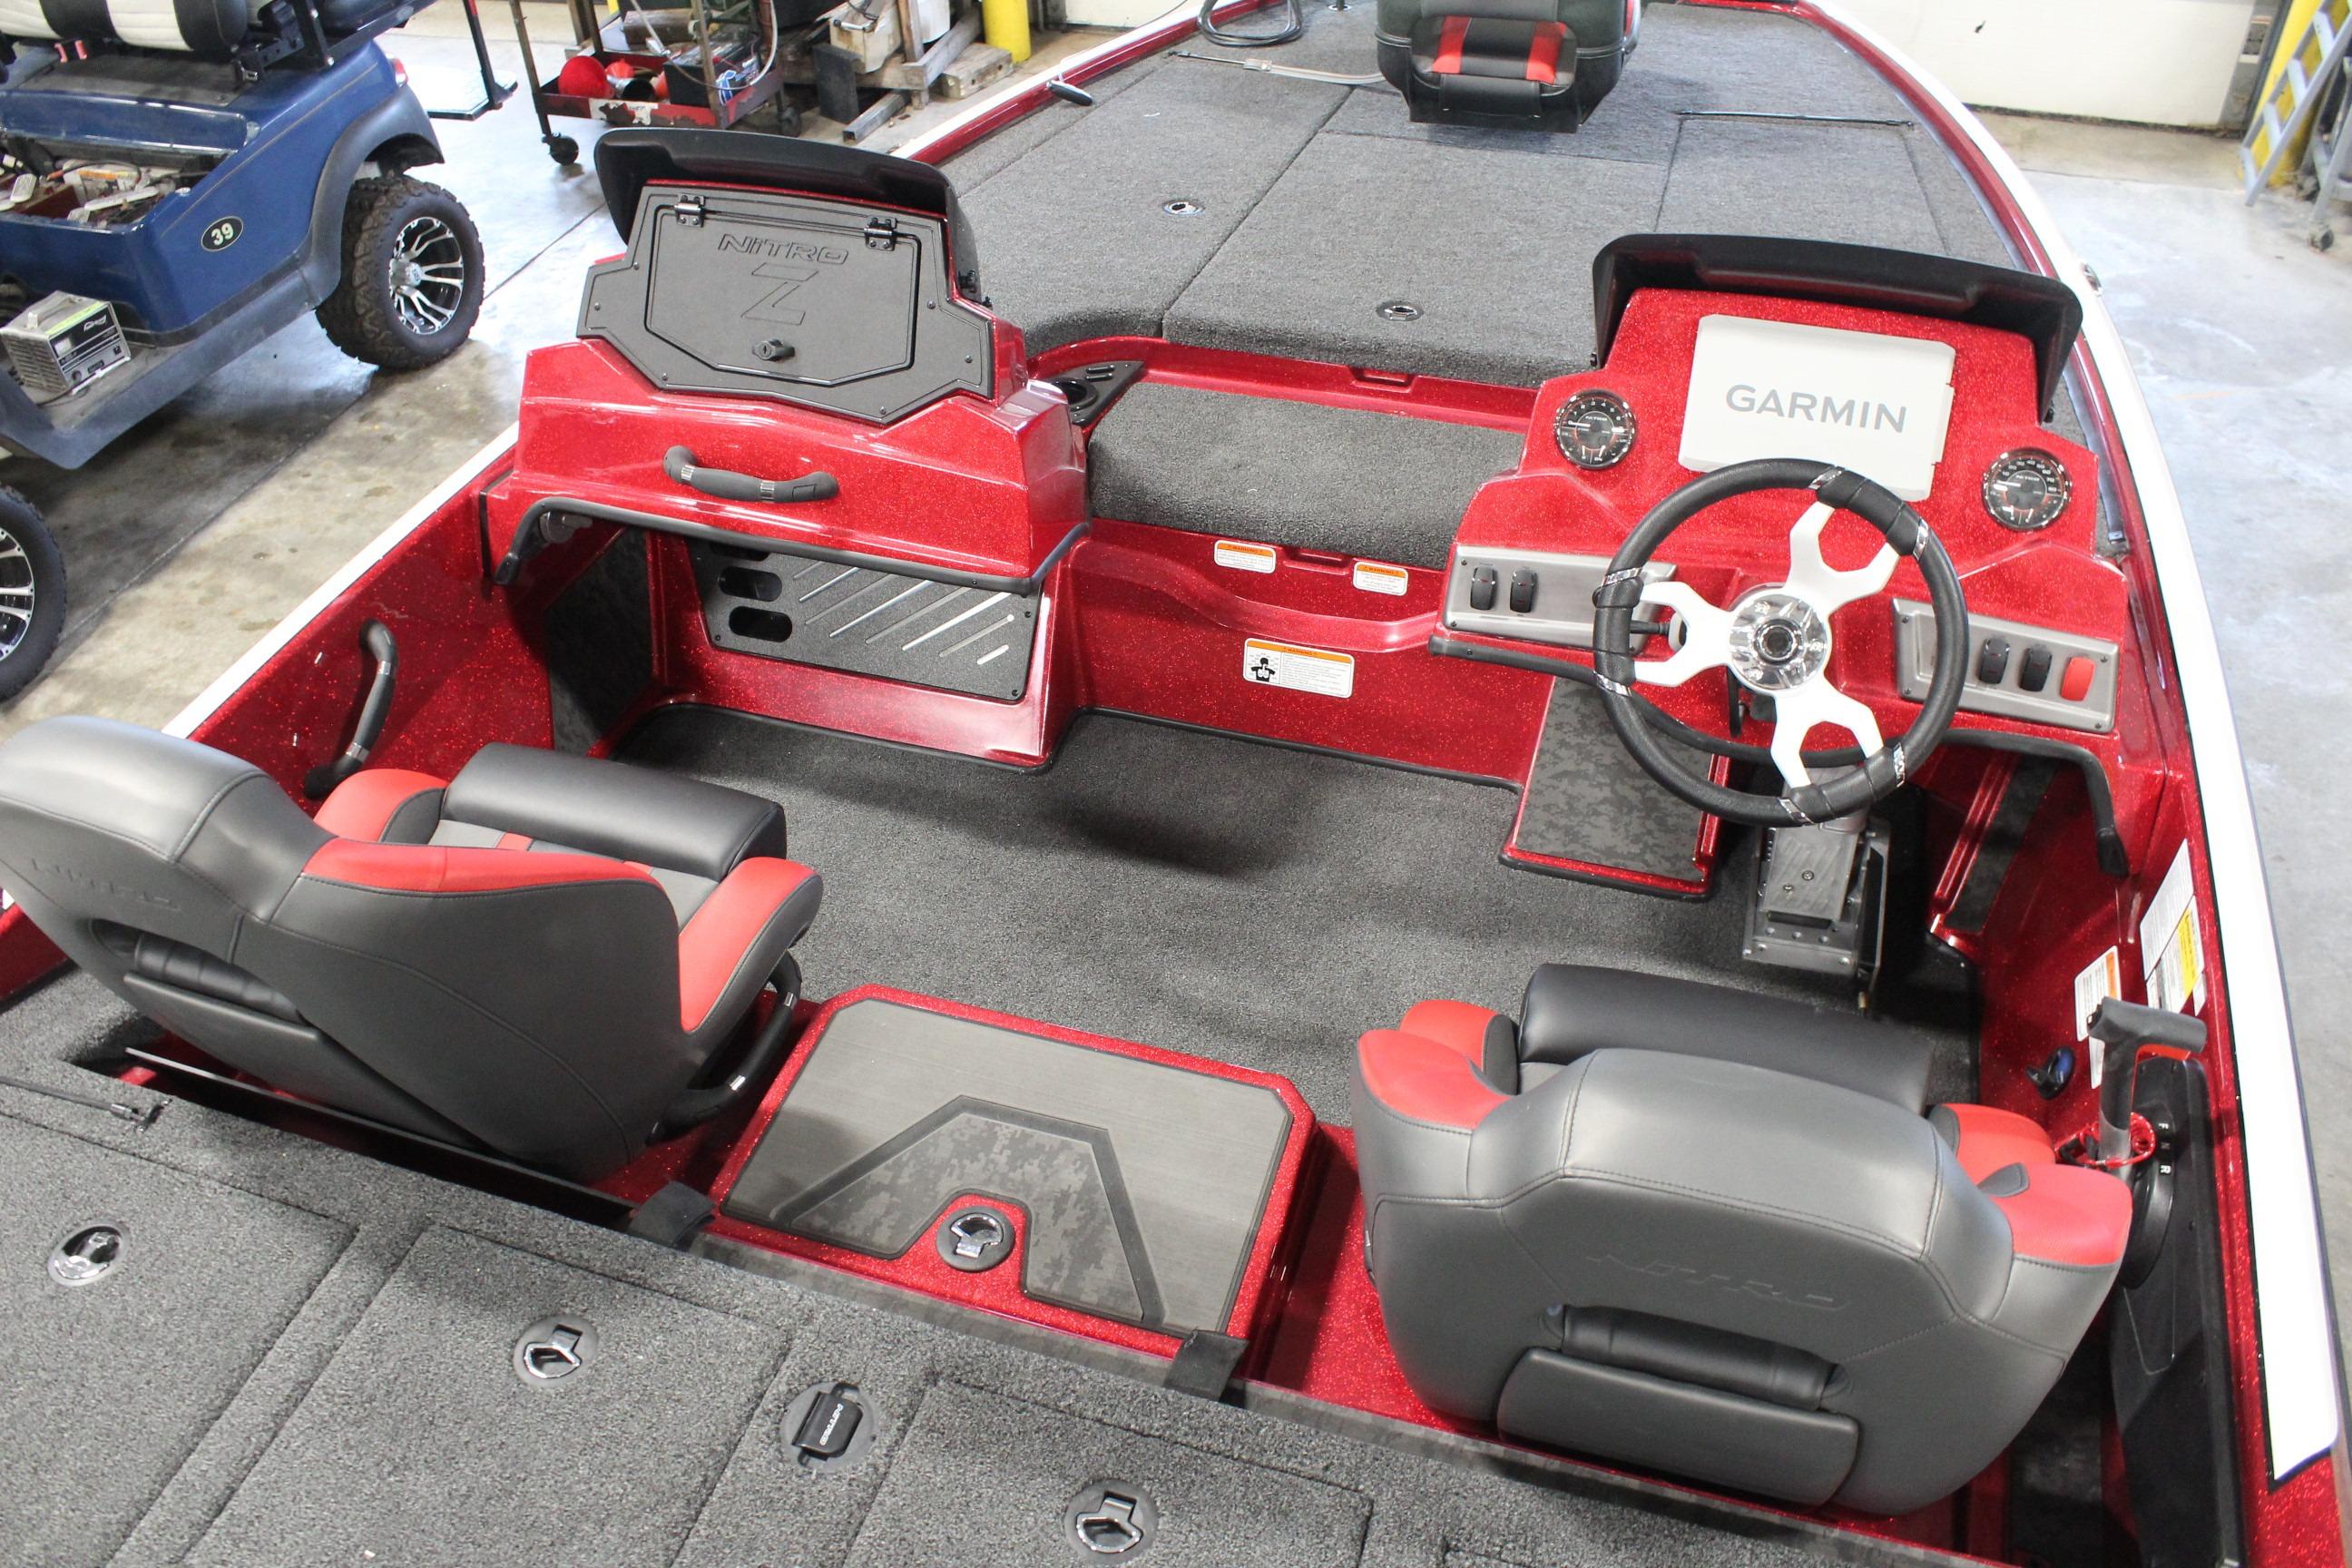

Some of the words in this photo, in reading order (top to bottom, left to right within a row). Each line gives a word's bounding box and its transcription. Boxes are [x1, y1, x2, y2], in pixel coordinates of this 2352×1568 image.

[211, 222, 234, 246] 39
[718, 233, 849, 265] NITRO
[740, 262, 818, 327] Z
[1726, 384, 1906, 434] GARMIN
[2160, 1164, 2171, 1174] R
